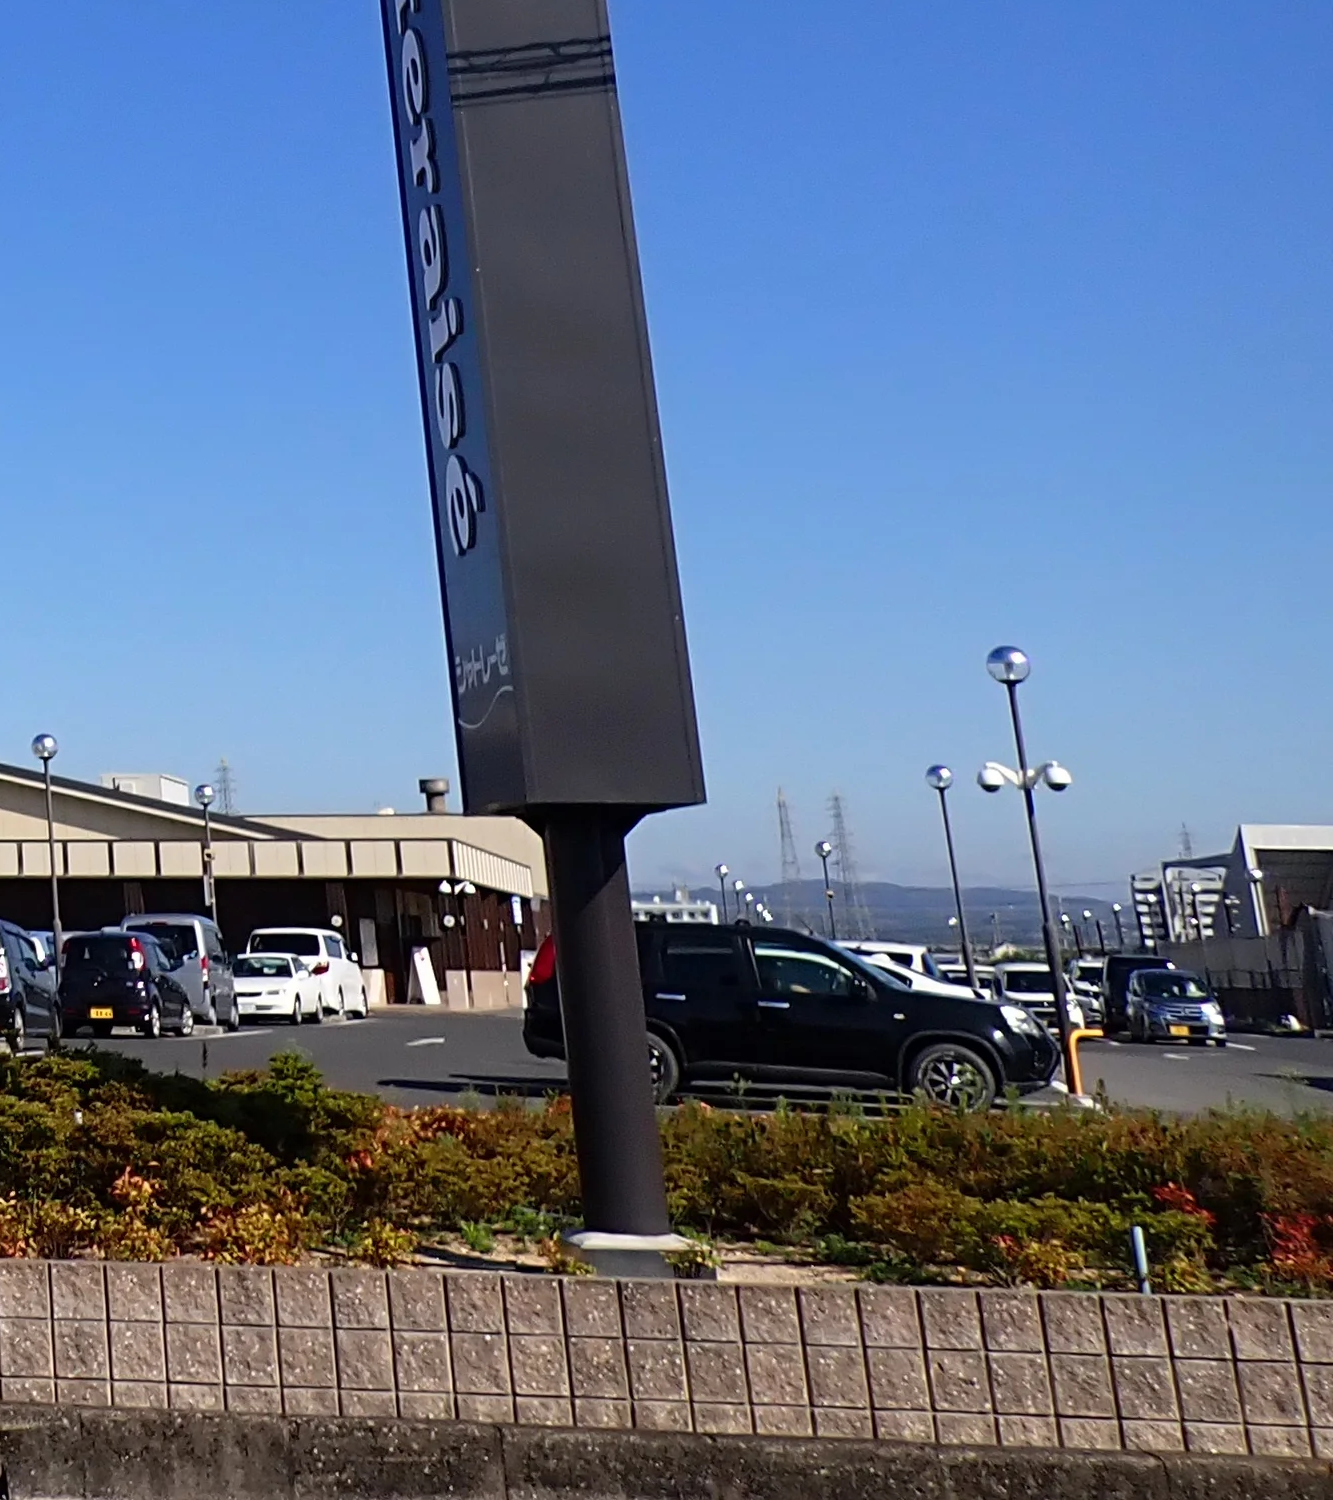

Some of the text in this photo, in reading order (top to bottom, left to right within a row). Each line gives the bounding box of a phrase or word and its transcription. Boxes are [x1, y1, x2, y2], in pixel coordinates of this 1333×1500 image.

[455, 632, 509, 693] シャトレーゼ
